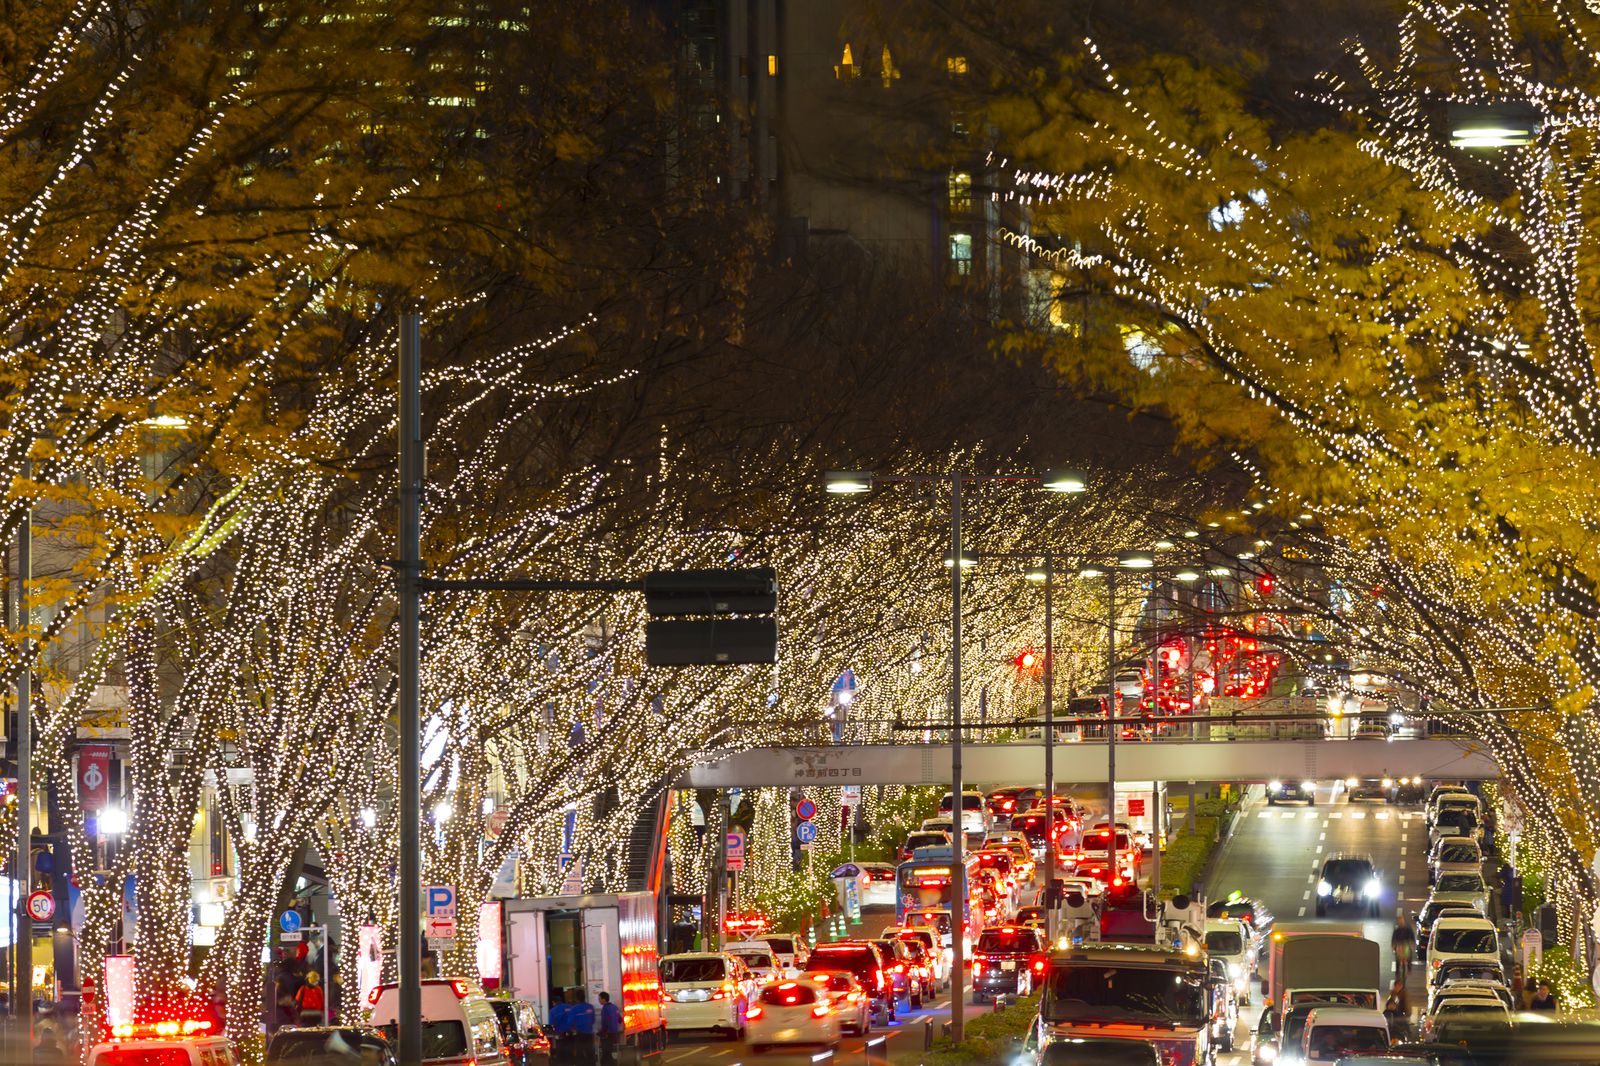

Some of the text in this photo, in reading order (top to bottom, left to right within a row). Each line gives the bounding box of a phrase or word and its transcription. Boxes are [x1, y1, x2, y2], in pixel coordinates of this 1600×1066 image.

[801, 826, 809, 840] P
[33, 898, 48, 912] 50
[429, 888, 452, 915] P
